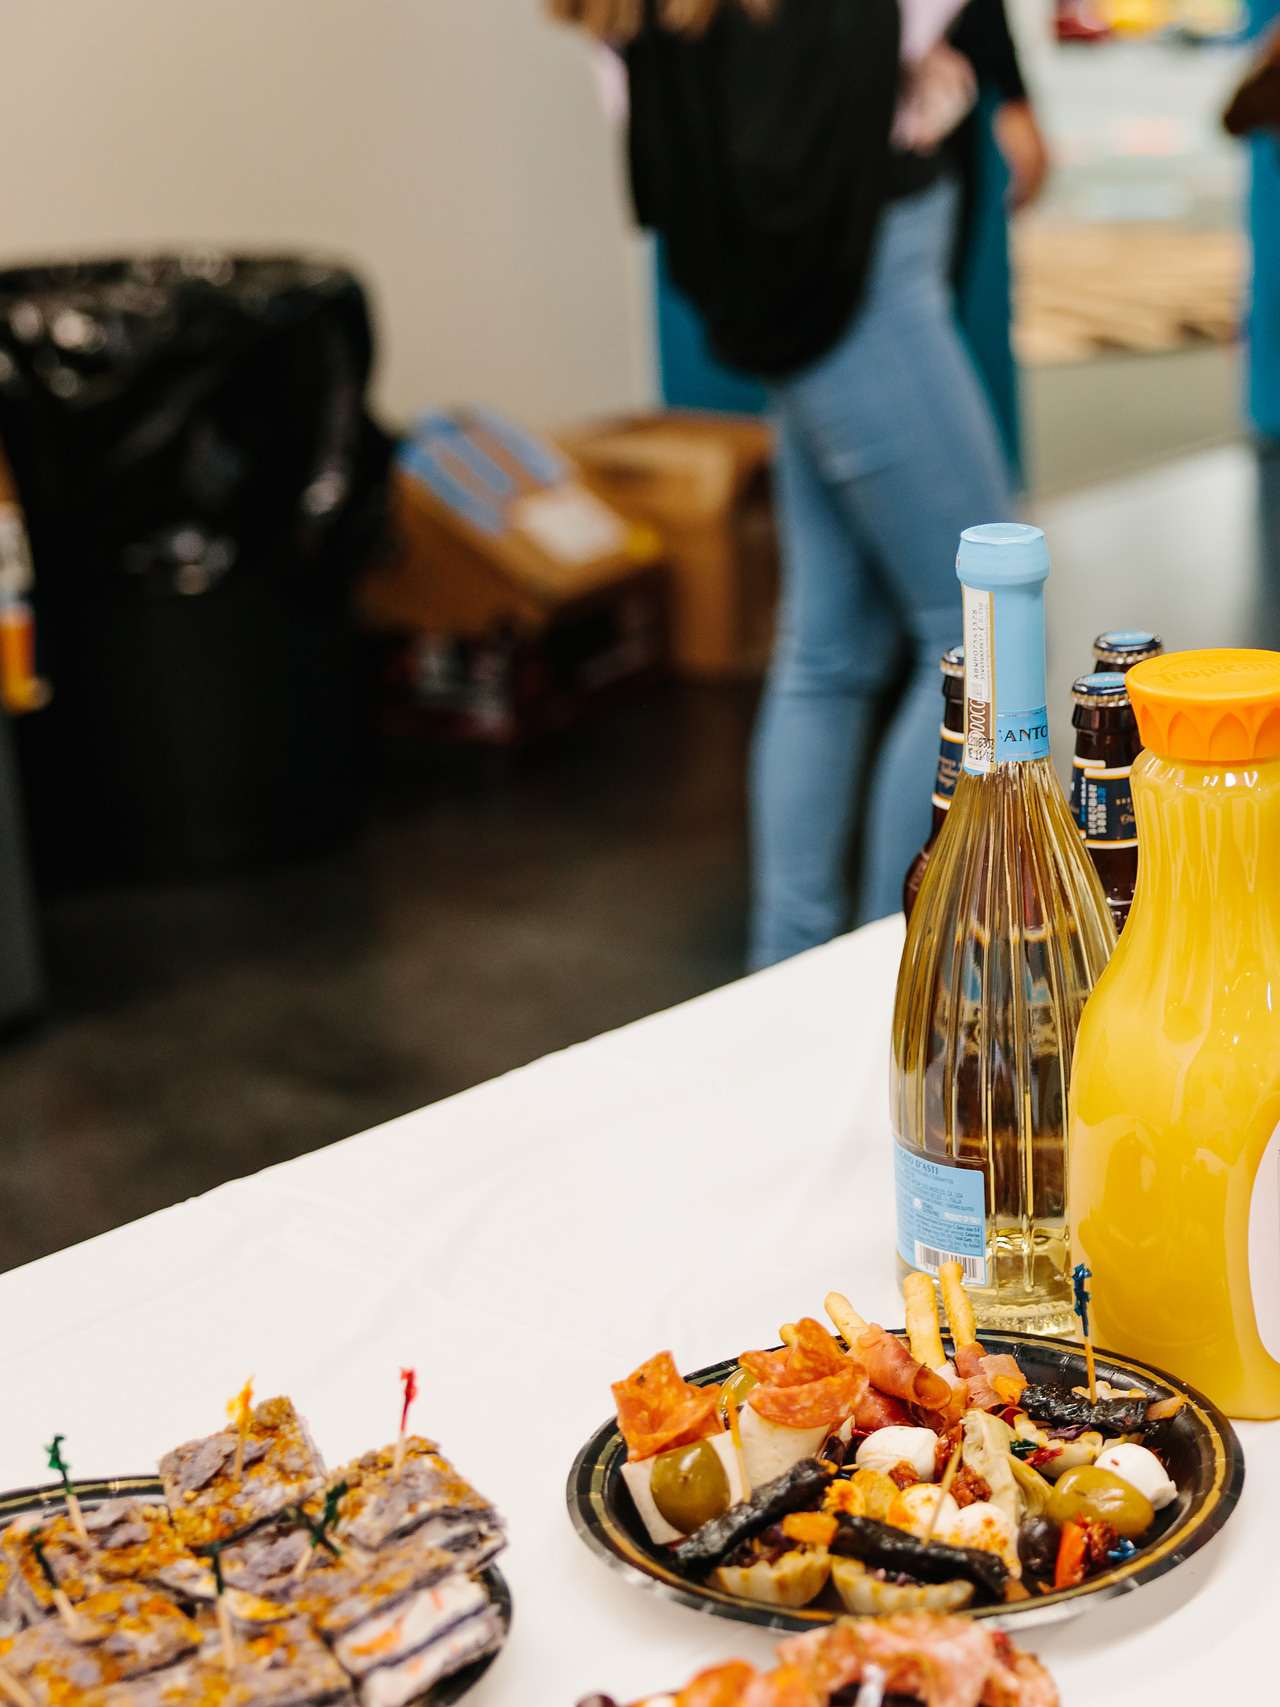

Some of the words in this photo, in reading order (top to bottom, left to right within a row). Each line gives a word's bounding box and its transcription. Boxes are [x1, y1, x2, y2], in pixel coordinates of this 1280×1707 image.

[968, 698, 986, 733] DOCG
[999, 724, 1048, 743] ANTO
[916, 1160, 939, 1175] D'ASTI
